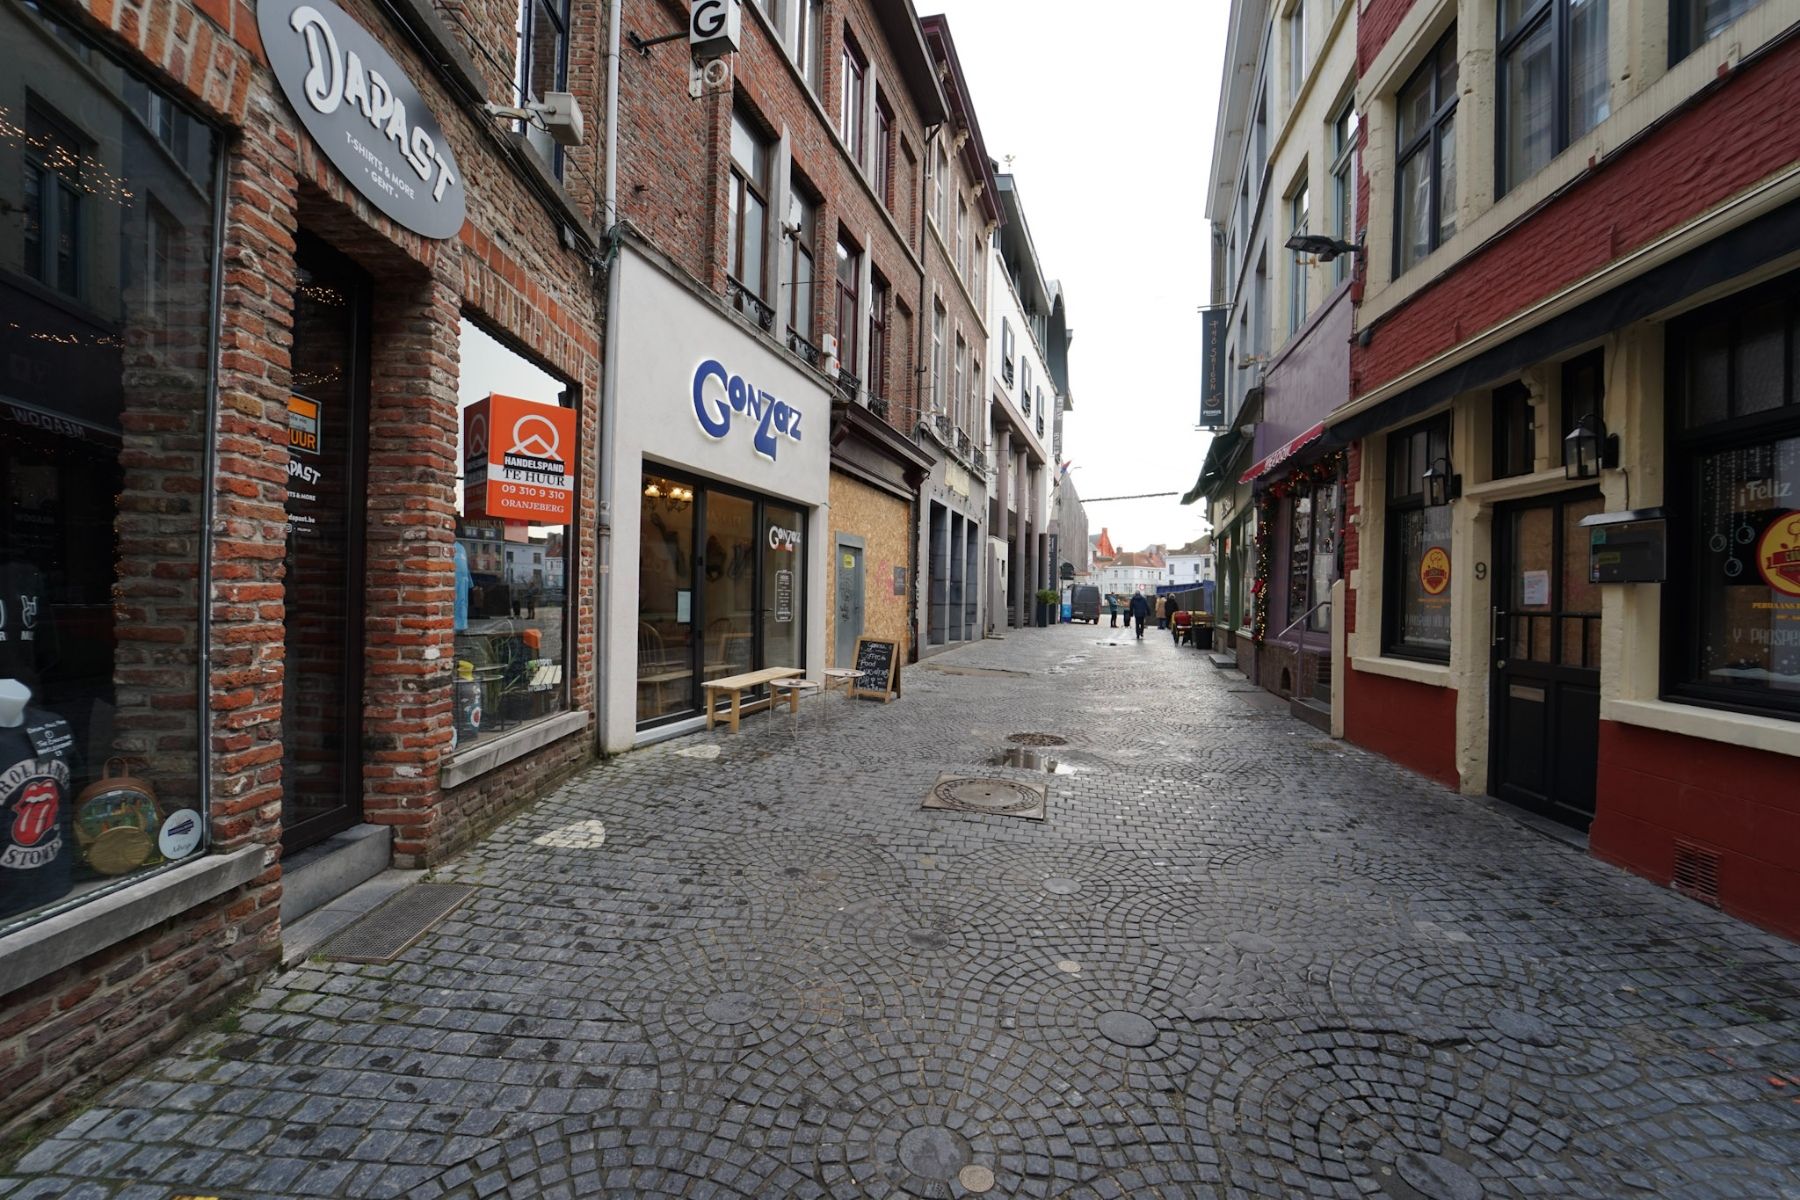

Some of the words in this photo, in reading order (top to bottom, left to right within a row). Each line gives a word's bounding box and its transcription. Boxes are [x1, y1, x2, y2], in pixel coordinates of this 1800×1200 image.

[290, 5, 456, 202] DAPAST
[345, 131, 384, 173] T-SHIRTS
[384, 167, 394, 179] &
[391, 173, 415, 201] MORE
[371, 171, 395, 197] GENT
[504, 456, 565, 473] HANDELSPAND
[502, 469, 521, 481] TE
[525, 471, 566, 488] HUUR
[501, 485, 516, 494] 09
[519, 486, 536, 497] 310
[539, 489, 546, 498] 9
[548, 490, 566, 501] 310
[501, 498, 565, 514] ORANJEBERG
[1475, 562, 1487, 580] 9
